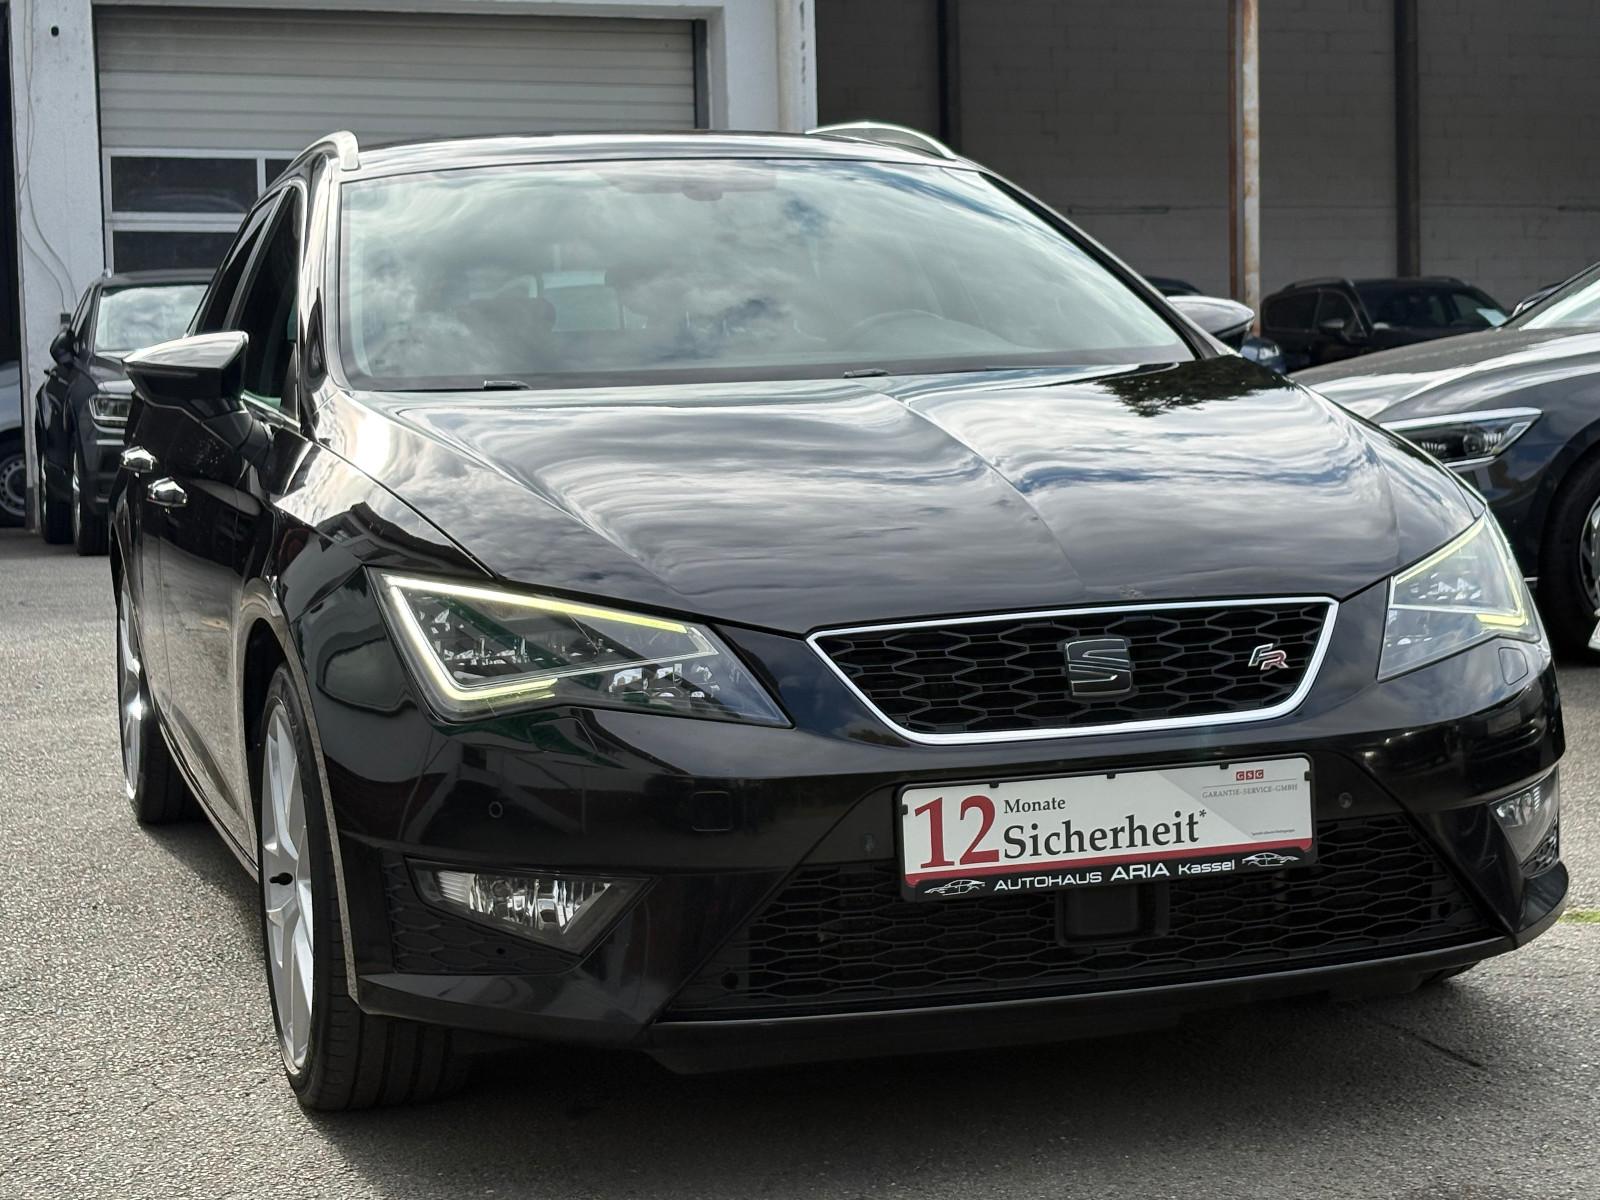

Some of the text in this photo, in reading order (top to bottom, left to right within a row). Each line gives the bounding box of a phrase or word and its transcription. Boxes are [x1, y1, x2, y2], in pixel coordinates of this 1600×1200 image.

[1248, 643, 1289, 670] FR
[1236, 769, 1264, 781] GSG
[1004, 797, 1066, 814] Monate
[914, 795, 1000, 869] 12
[994, 859, 1235, 891] AUTOHAUS ARIA Kassel
